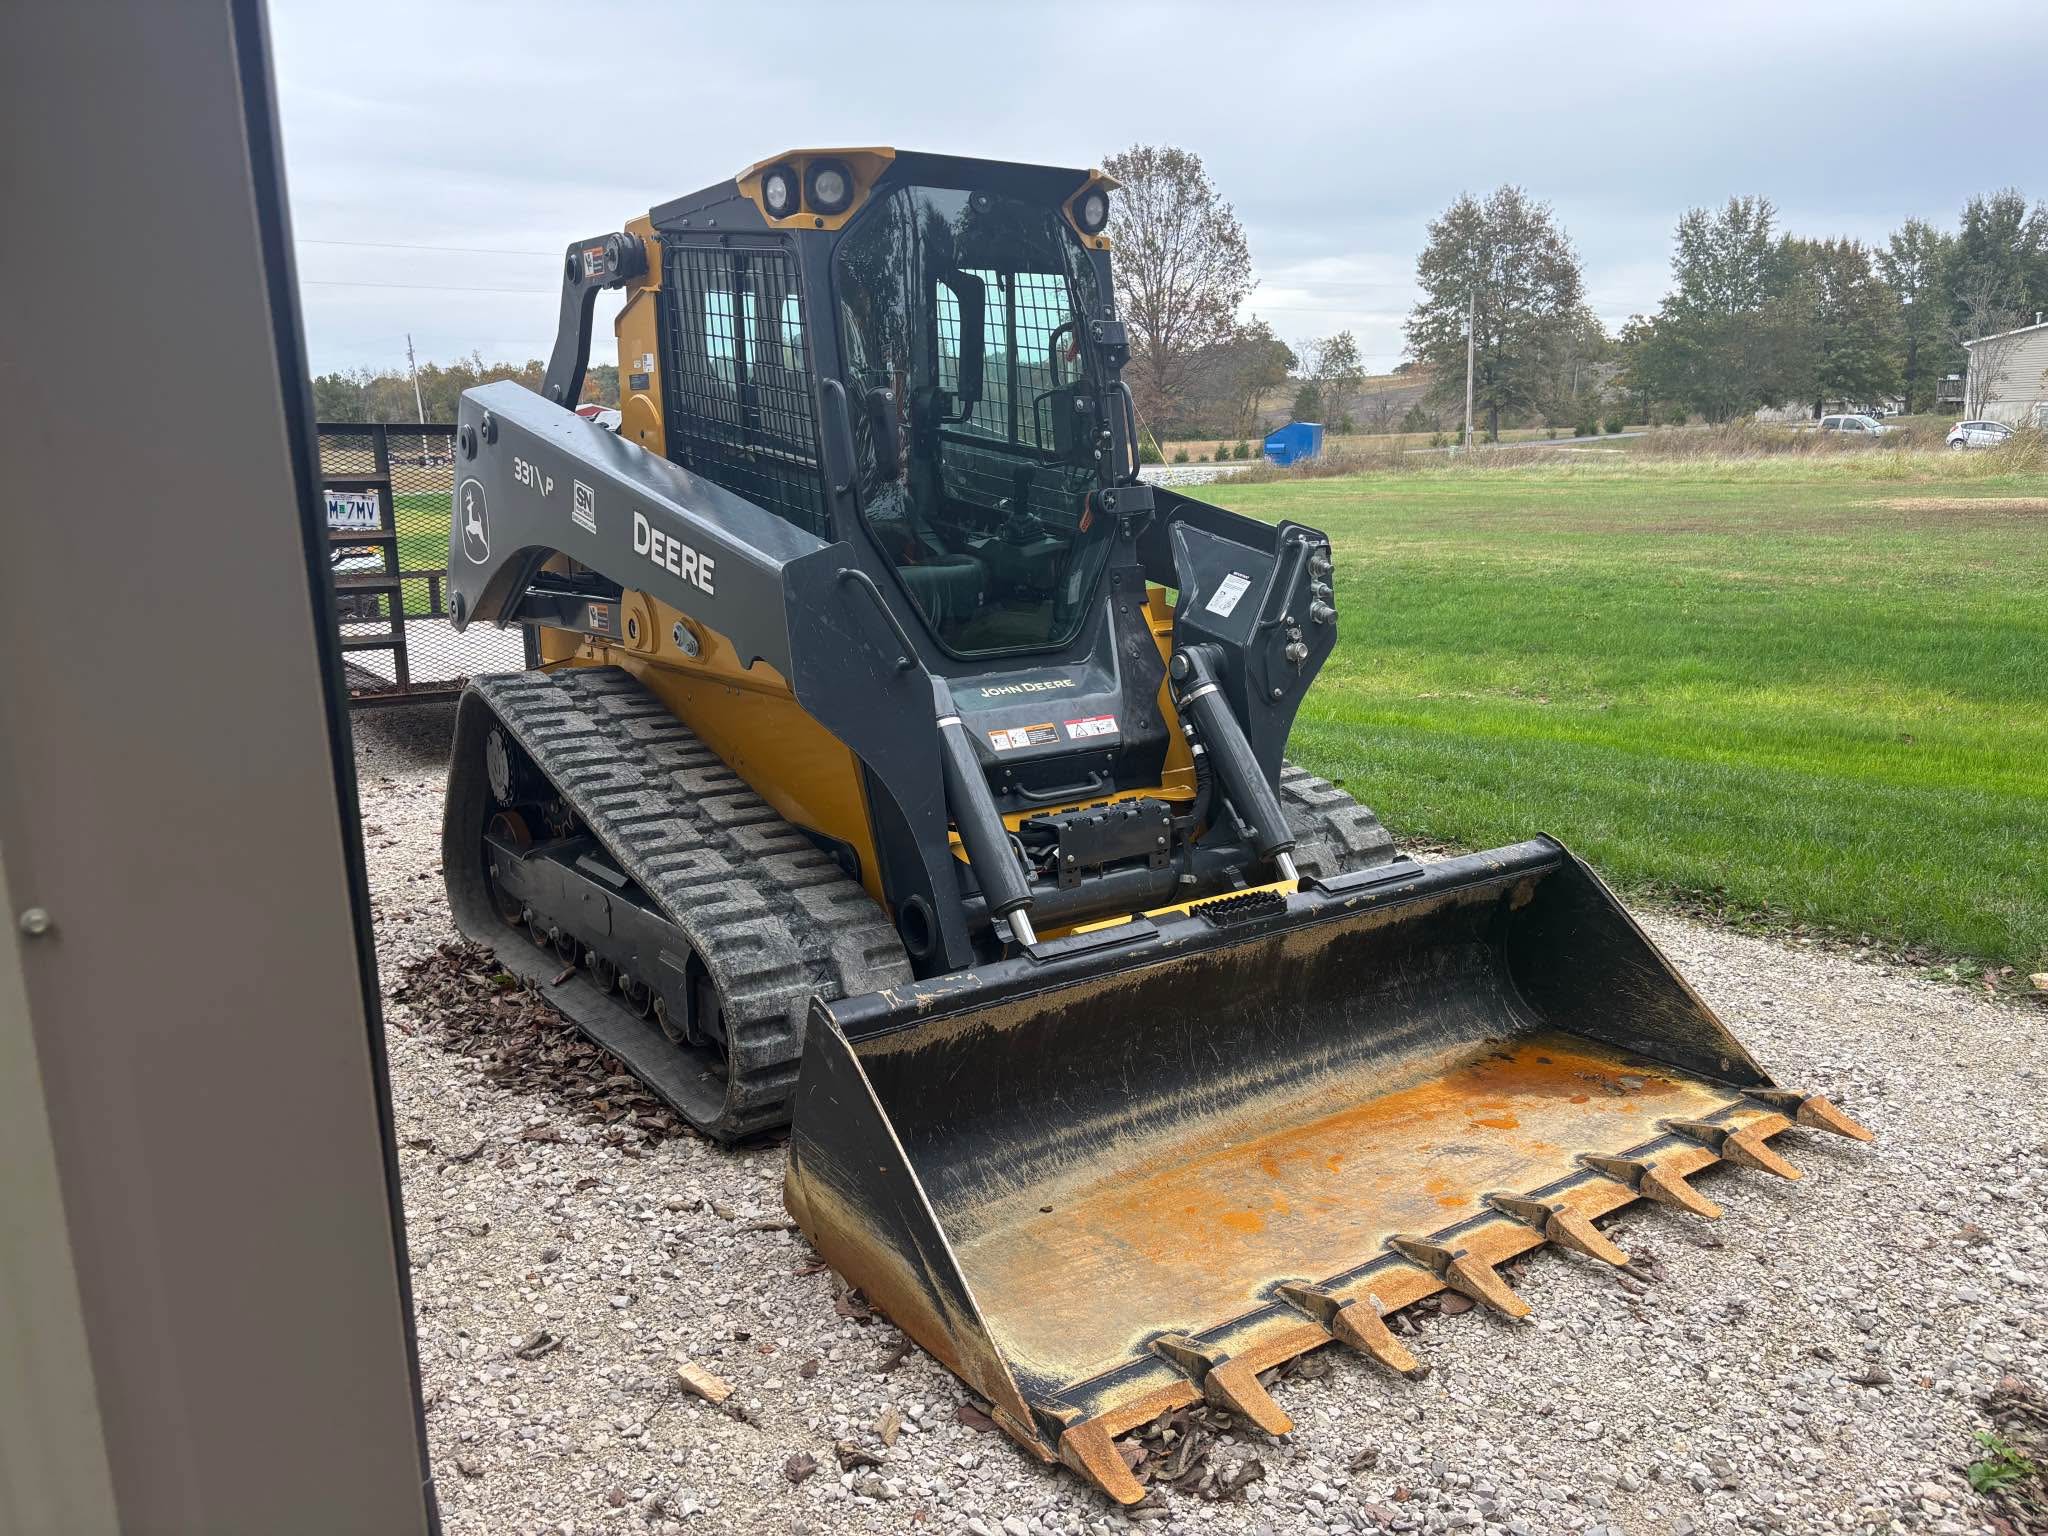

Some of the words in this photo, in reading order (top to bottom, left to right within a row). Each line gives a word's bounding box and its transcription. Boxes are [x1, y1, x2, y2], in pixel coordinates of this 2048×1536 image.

[634, 511, 715, 595] DEERE
[981, 685, 1022, 698] JOHN
[1022, 679, 1076, 692] DEERE
